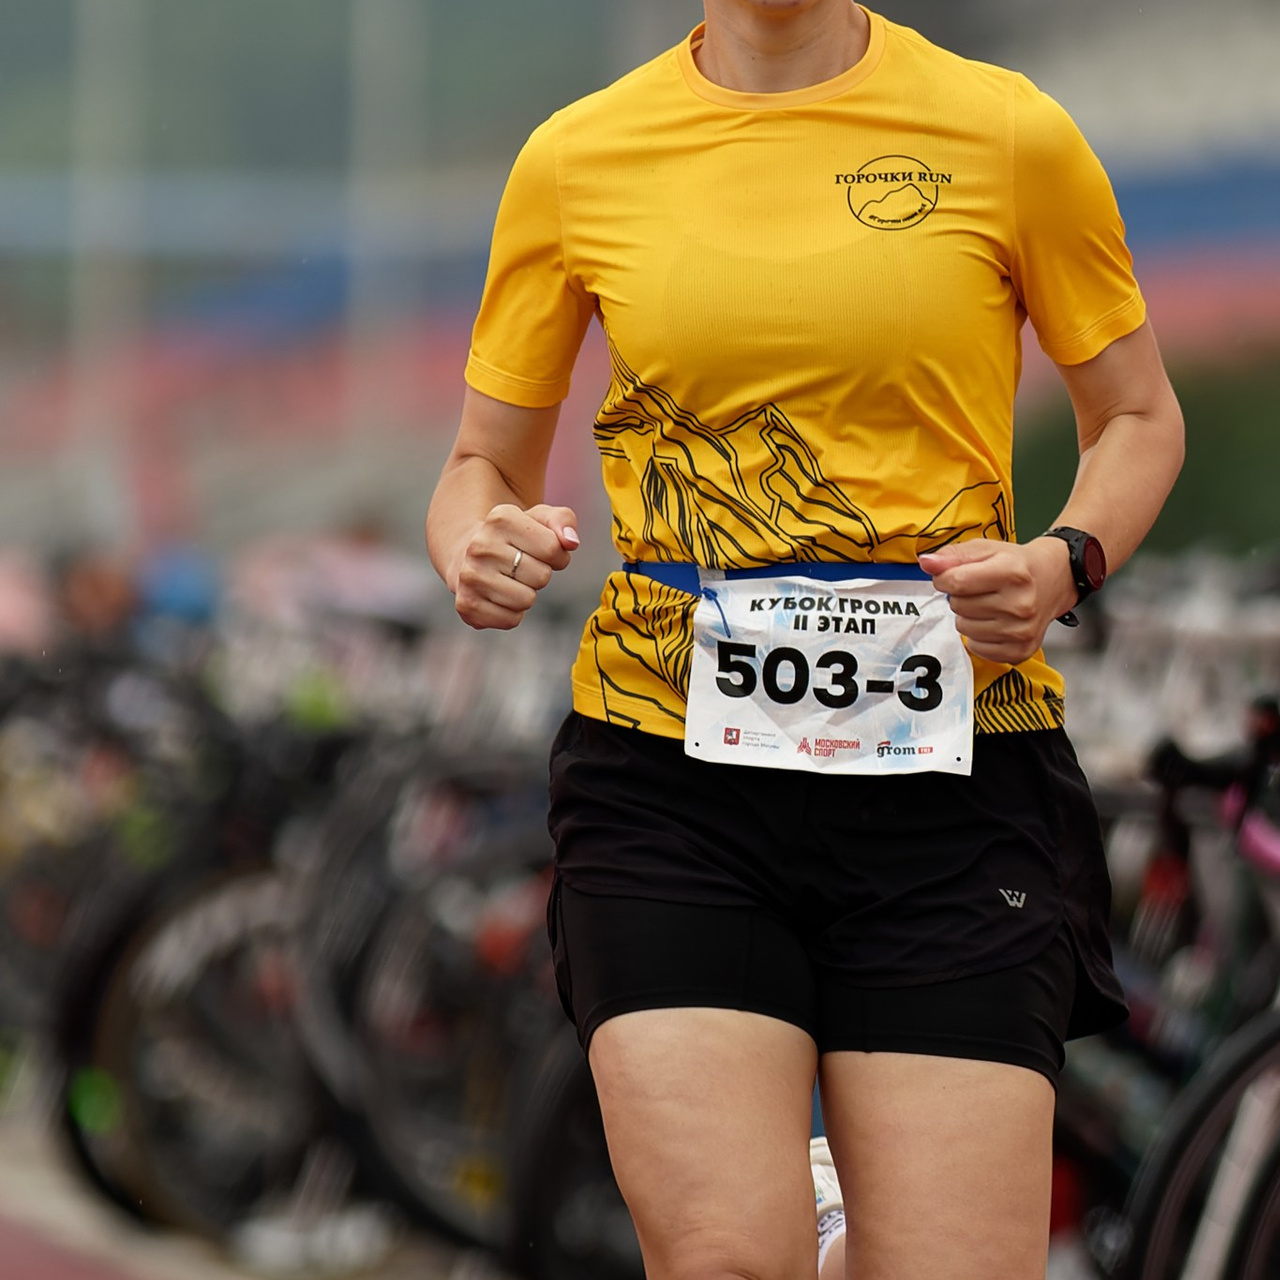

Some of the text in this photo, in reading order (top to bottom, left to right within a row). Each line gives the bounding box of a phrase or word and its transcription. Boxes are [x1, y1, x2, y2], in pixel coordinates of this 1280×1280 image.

[835, 172, 952, 184] ГОРОЧКИ RUN
[750, 597, 920, 616] КУБОК ГРОМА
[817, 616, 876, 635] ЭТАП
[715, 640, 943, 712] 503-3
[814, 738, 860, 750] МОСКОВСКИЙ
[813, 747, 836, 758] СПОРТ
[876, 745, 916, 758] grom
